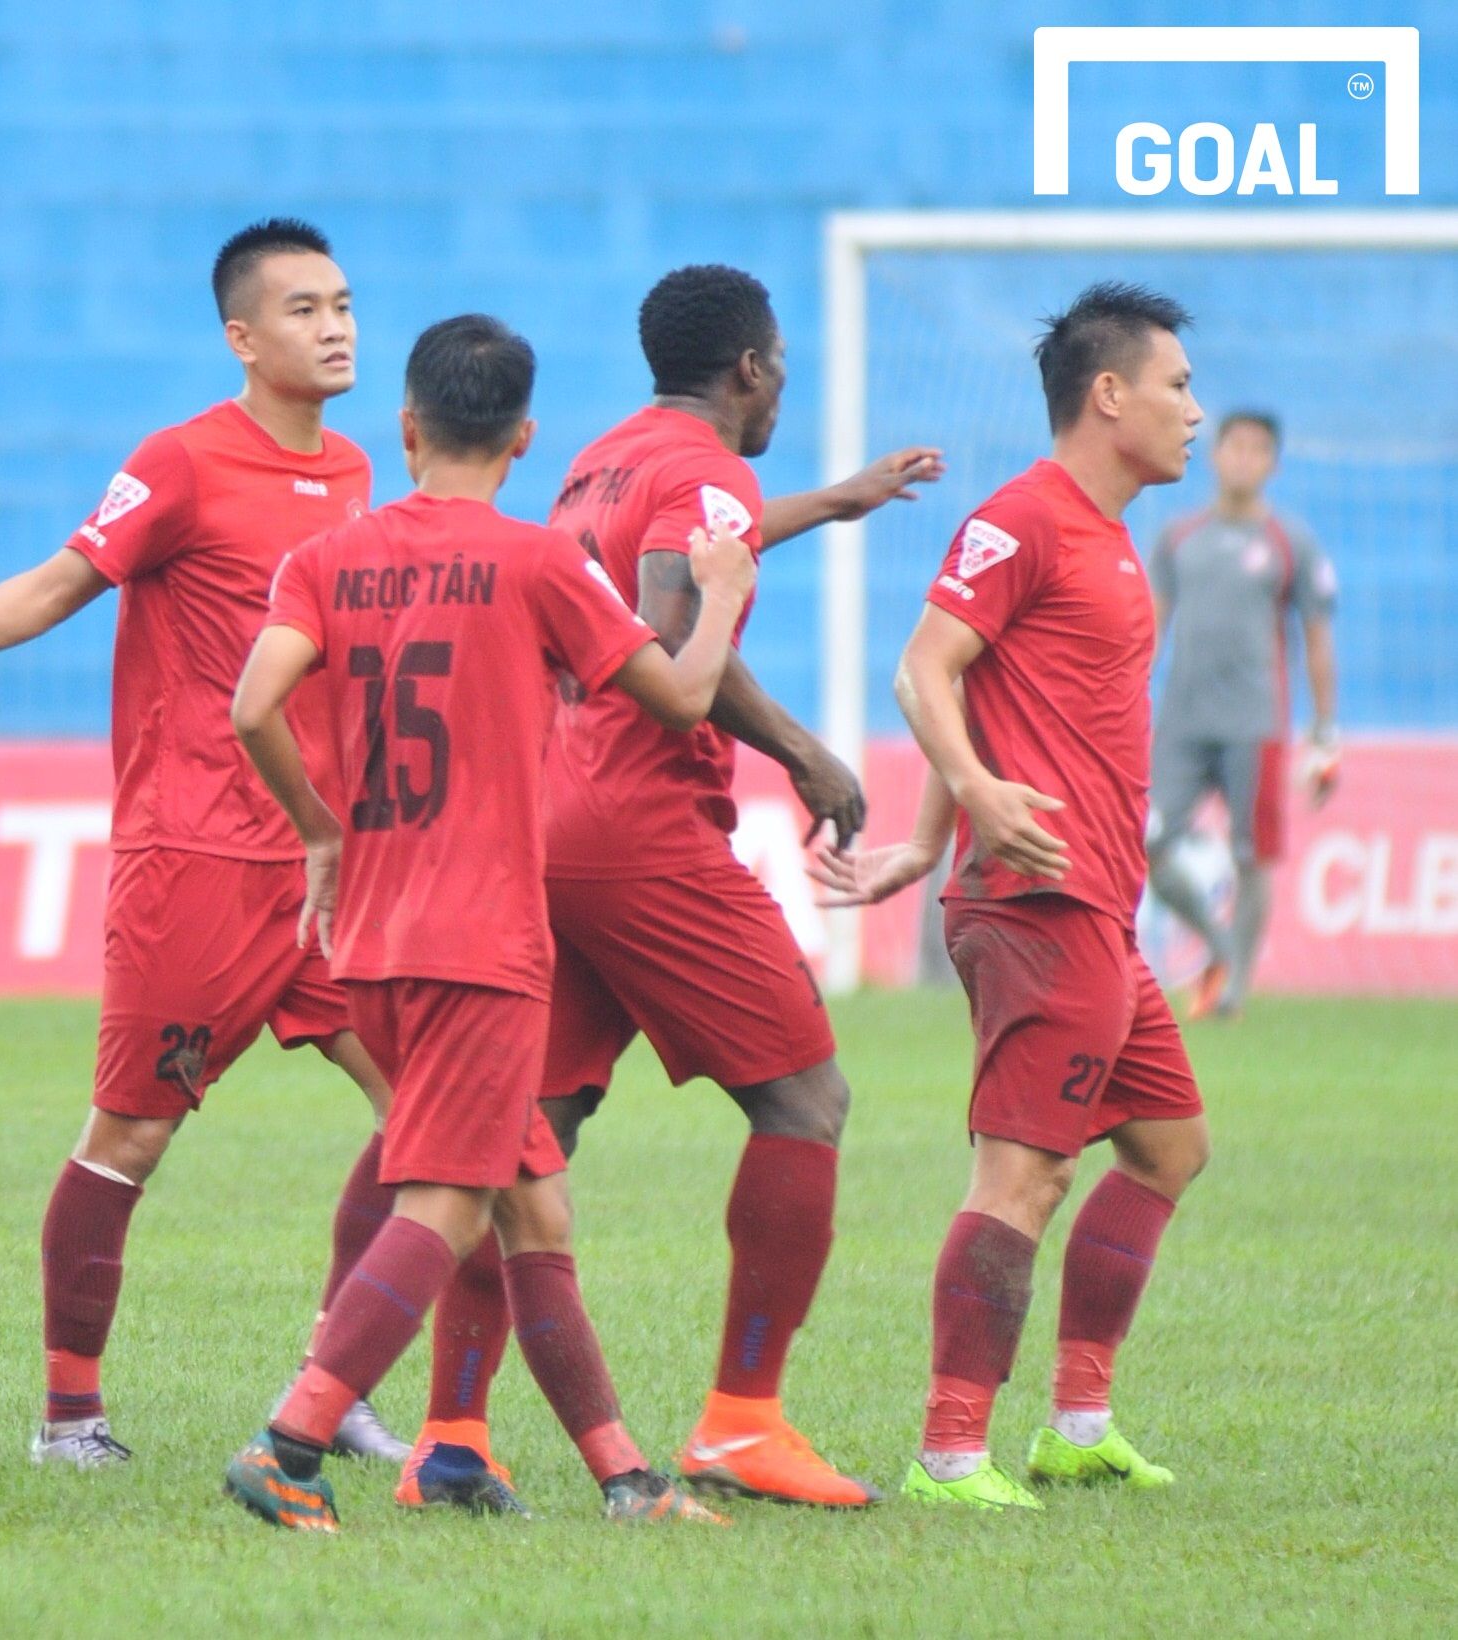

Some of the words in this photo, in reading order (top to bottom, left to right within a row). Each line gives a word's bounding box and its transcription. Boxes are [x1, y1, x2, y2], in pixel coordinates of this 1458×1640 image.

[333, 564, 419, 621] NGỌC
[427, 551, 497, 606] TÂN
[348, 640, 453, 833] 15
